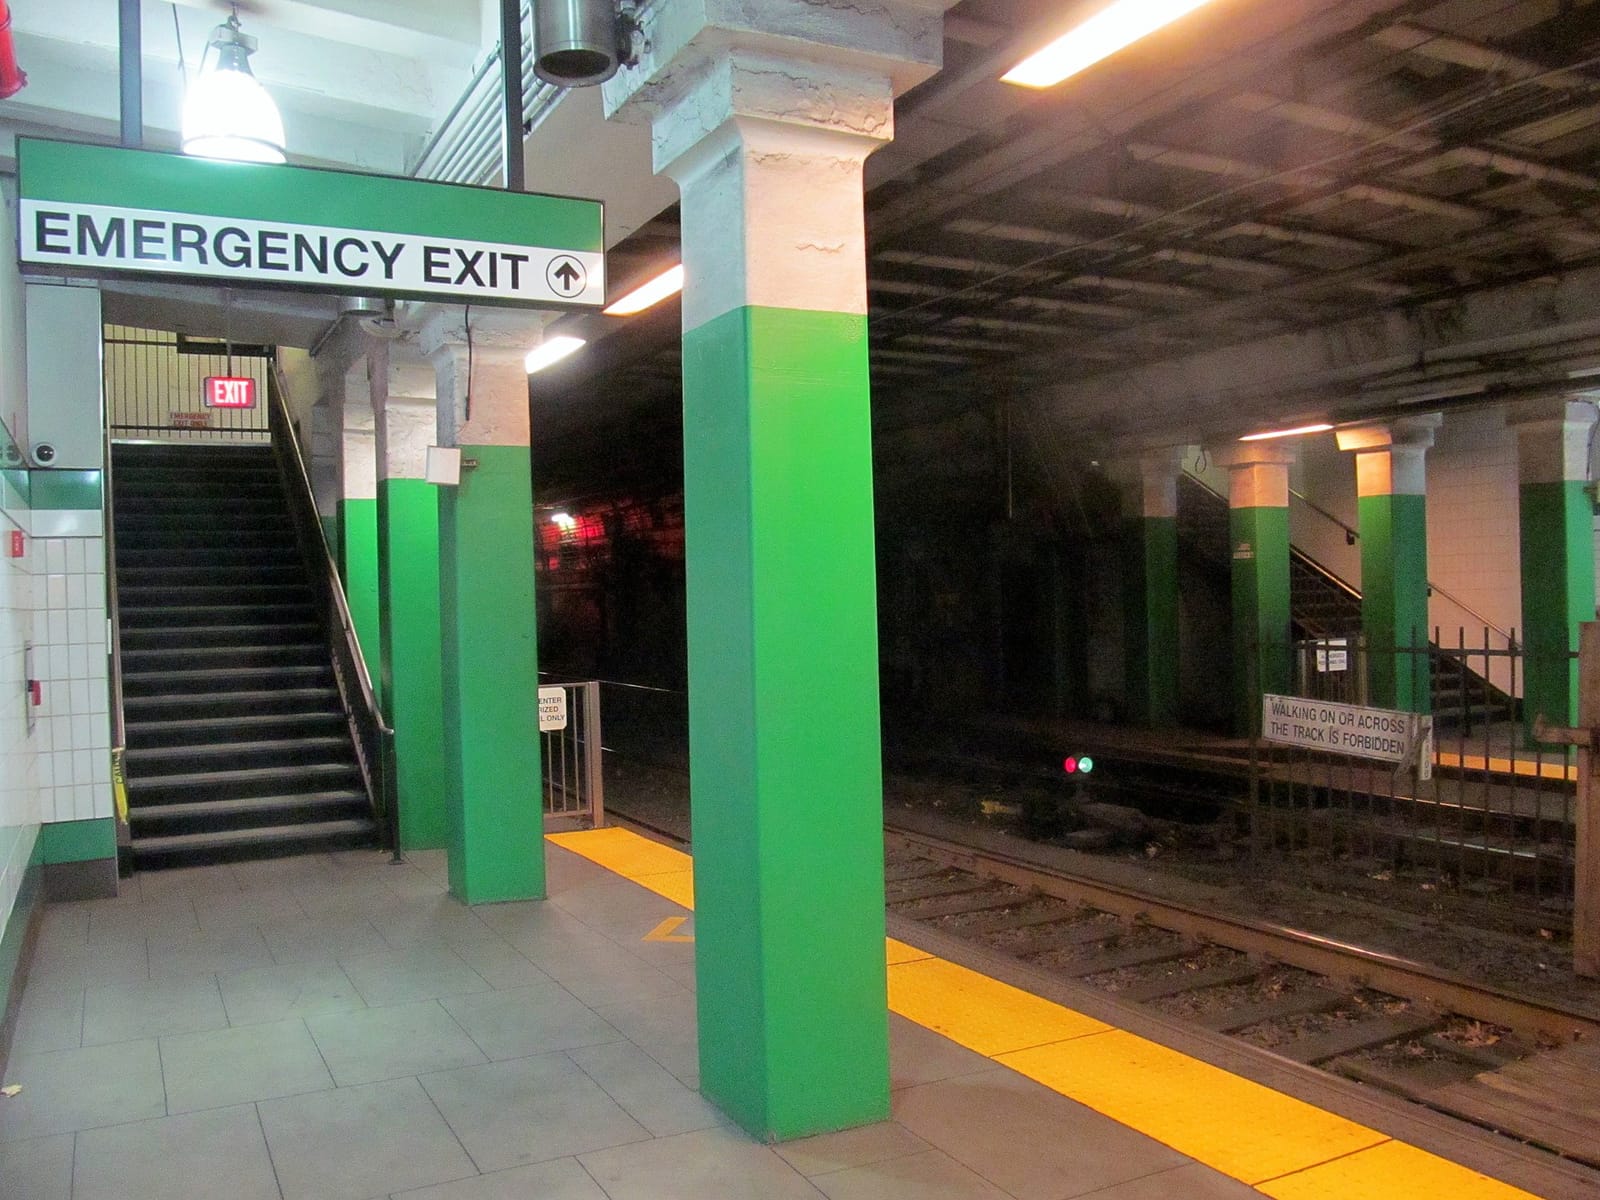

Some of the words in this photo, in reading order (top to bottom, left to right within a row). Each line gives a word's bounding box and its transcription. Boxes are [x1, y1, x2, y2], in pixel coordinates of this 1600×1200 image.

[35, 209, 406, 280] EMERGENCY
[423, 245, 530, 290] EXIT
[213, 380, 249, 404] EXIT
[1271, 702, 1317, 721] WALKING
[1320, 709, 1336, 724] ON
[1339, 711, 1355, 727] OR
[1357, 714, 1405, 734] ACROSS
[1270, 721, 1289, 737] THE
[1293, 724, 1325, 742] TRACK
[1328, 725, 1339, 745] IS
[1343, 732, 1405, 755] FORBIDDEN
